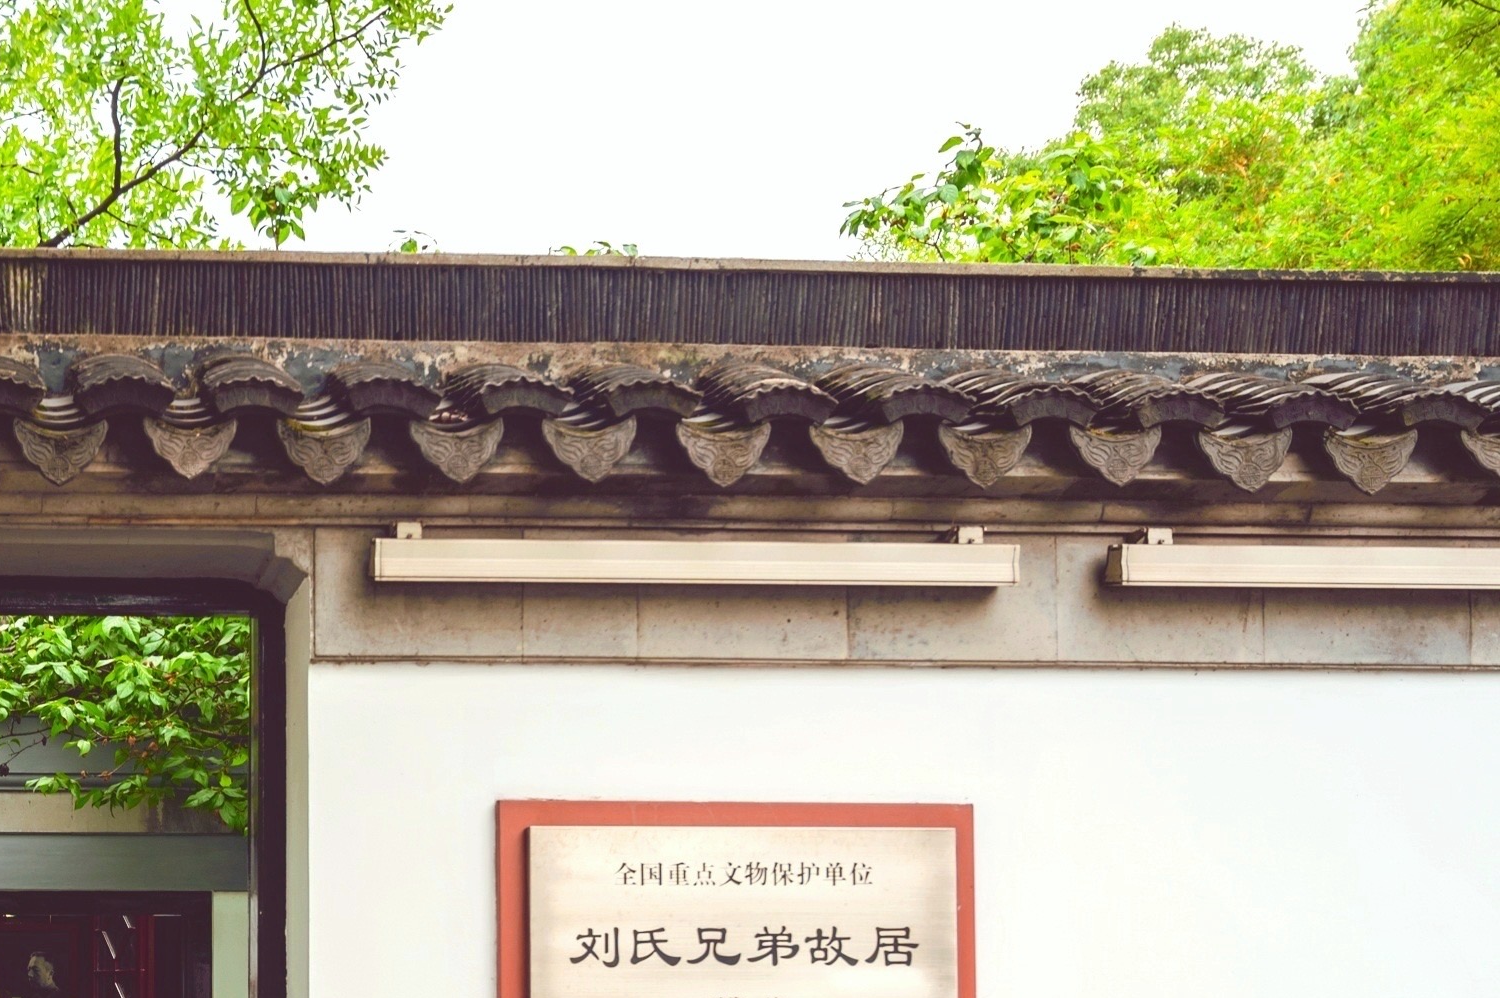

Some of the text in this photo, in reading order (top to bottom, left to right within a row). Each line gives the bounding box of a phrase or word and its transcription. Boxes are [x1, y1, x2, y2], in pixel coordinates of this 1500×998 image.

[614, 861, 874, 887] 全国重点文物保护单位
[569, 925, 920, 968] 刘氏兄弟故居
